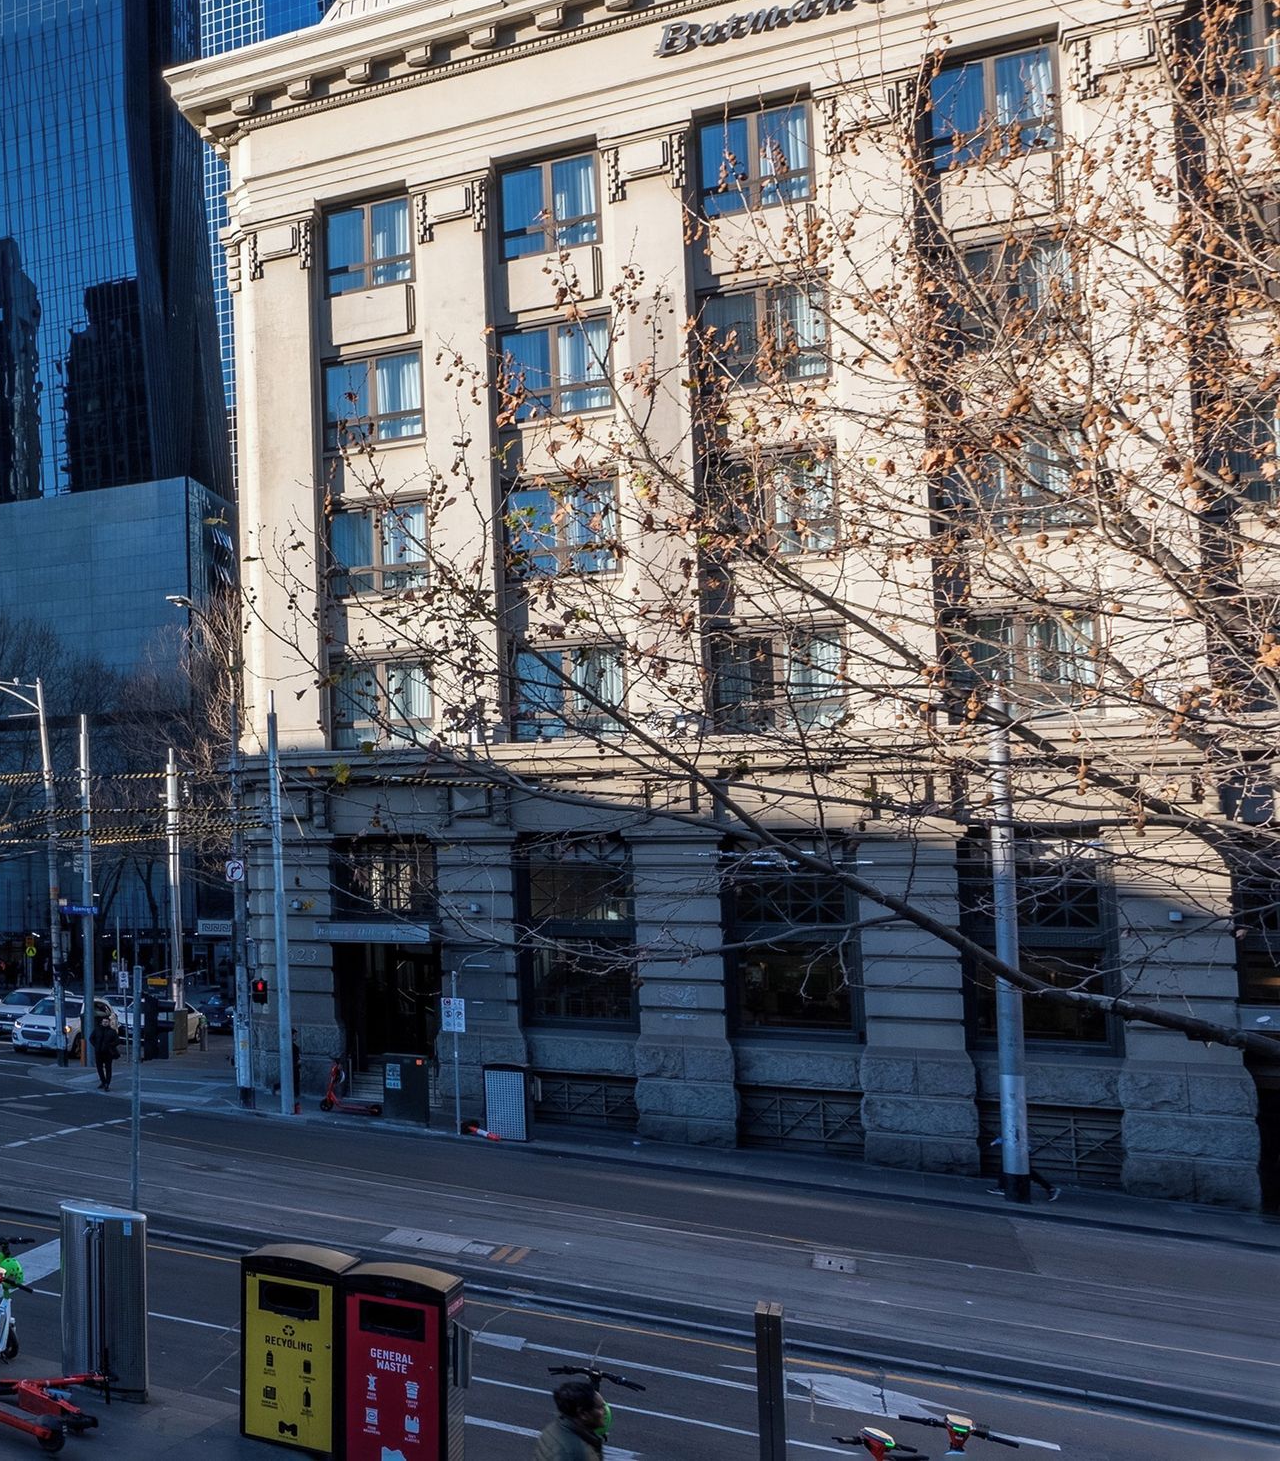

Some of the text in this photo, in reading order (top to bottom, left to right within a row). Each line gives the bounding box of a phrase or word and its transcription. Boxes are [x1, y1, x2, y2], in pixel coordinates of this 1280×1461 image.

[265, 1335, 313, 1353] RECYCLING
[370, 1347, 414, 1365] GENERAL
[376, 1359, 408, 1375] WASTE
